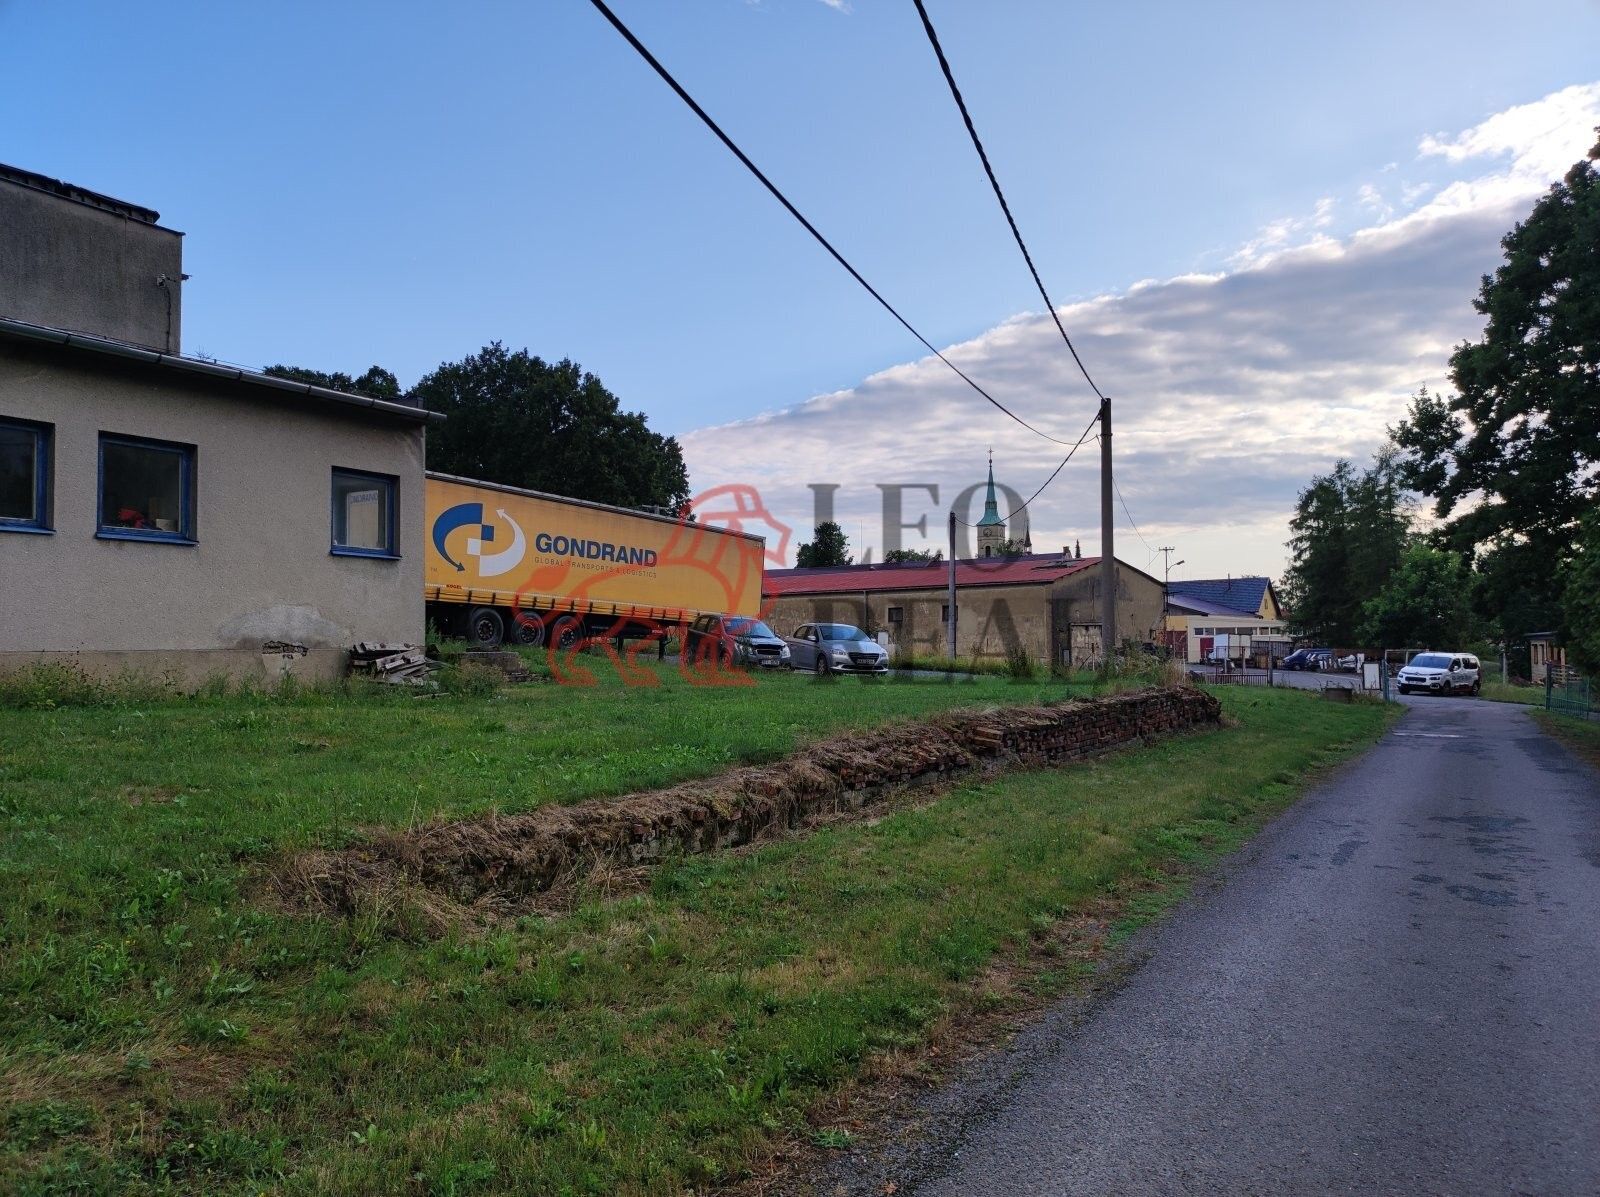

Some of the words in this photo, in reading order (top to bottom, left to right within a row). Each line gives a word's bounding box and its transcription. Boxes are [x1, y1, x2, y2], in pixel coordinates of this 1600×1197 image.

[536, 533, 657, 567] GONDRAND
[535, 556, 564, 567] GLOBAL
[567, 560, 613, 573] TRANSPORTS
[622, 568, 657, 579] LOGISTICS
